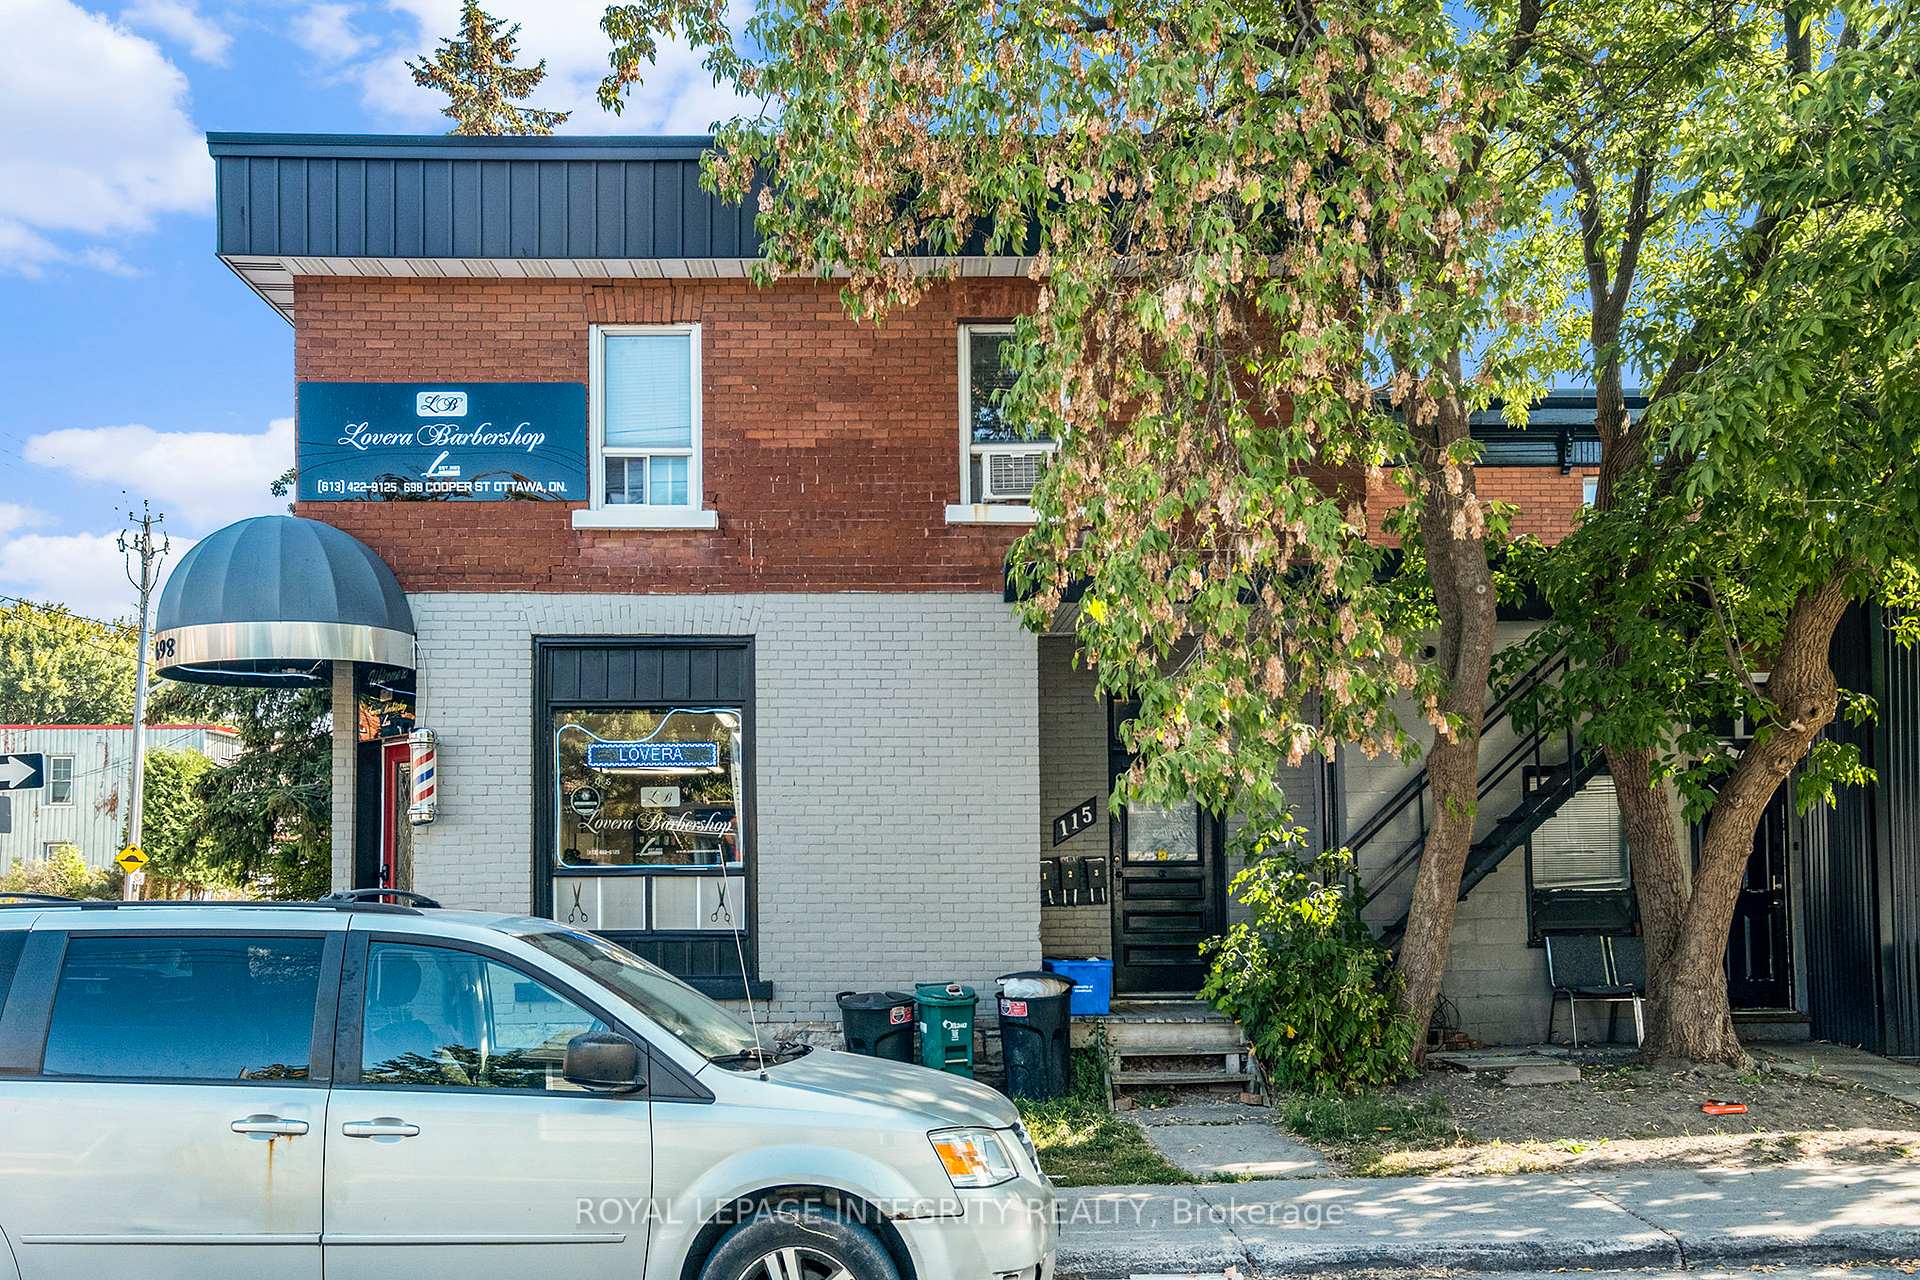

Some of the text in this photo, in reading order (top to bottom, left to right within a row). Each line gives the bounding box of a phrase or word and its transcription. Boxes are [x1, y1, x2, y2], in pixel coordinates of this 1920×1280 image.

[338, 422, 545, 451] Lovera Barbershop
[347, 481, 397, 493] 422-9125
[404, 482, 423, 493] 698
[425, 481, 472, 494] COOPER
[475, 481, 490, 493] ST
[494, 481, 546, 494] OTTAWA,
[549, 481, 567, 494] ON.
[619, 748, 683, 762] LOVERA
[578, 811, 733, 837] Lovera Barbershop
[1059, 806, 1093, 838] 115
